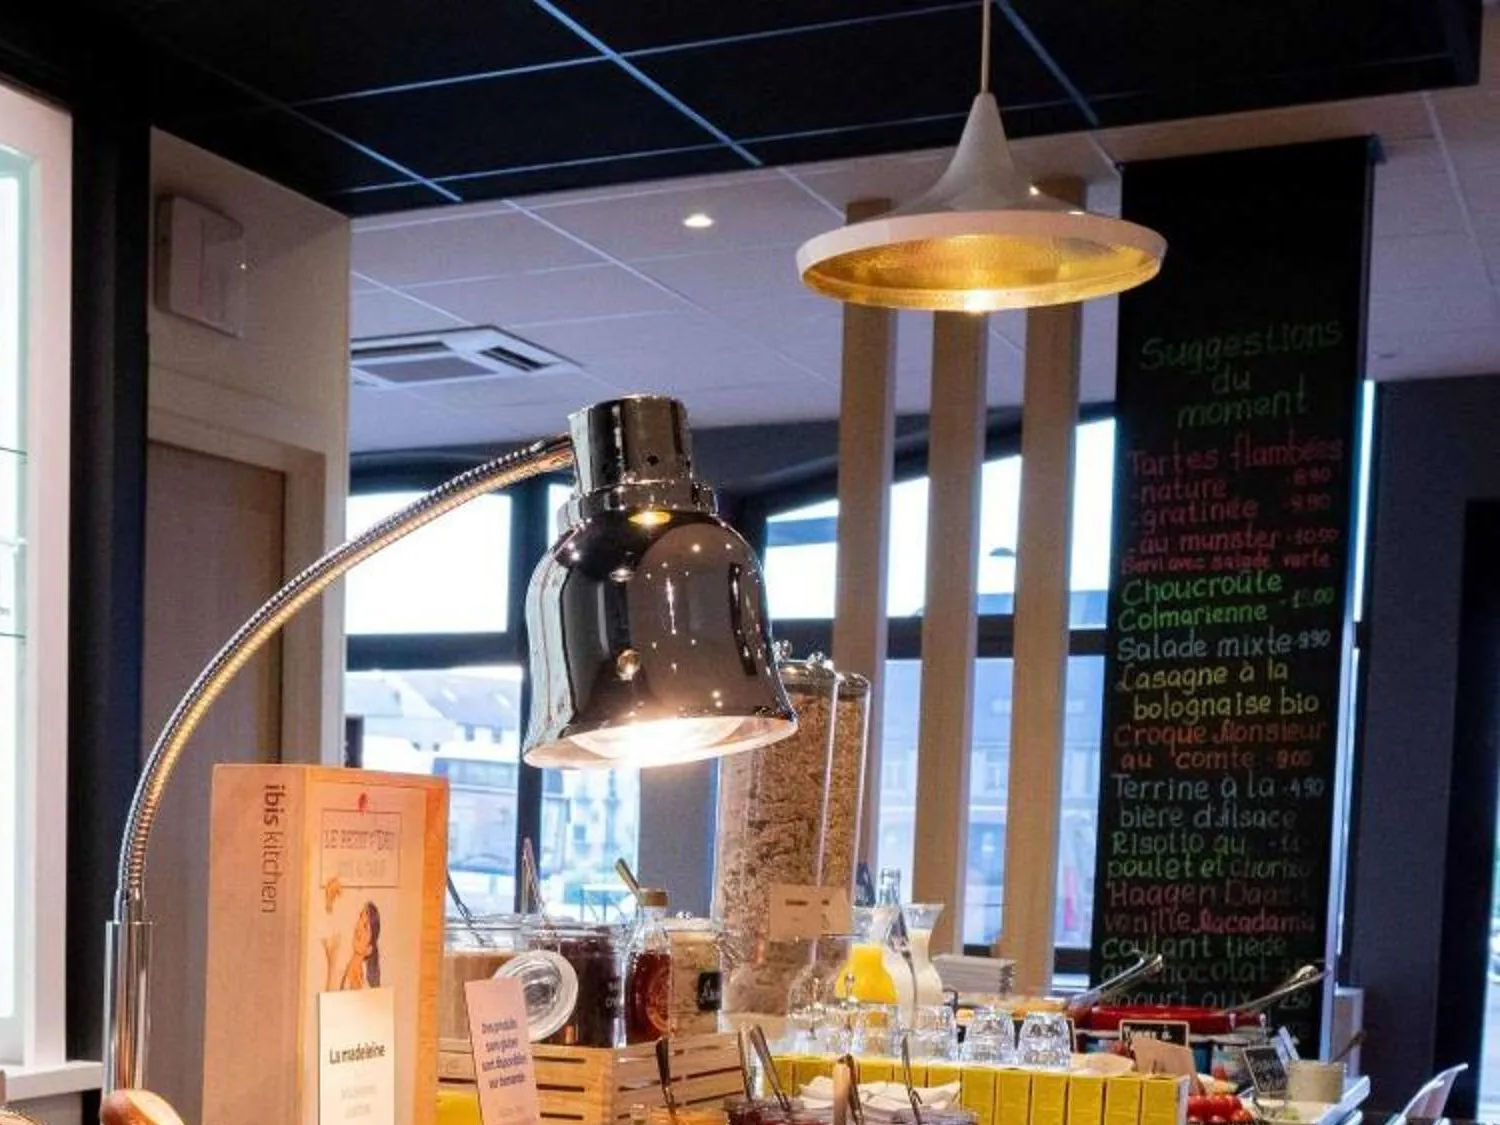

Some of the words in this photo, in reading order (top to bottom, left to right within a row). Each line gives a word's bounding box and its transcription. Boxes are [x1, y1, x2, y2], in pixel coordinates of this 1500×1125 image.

[1211, 362, 1251, 395] du
[1177, 373, 1311, 430] moment
[1129, 437, 1218, 476] Tartes
[1118, 603, 1269, 632] Colmarienne
[1117, 627, 1209, 662] Salade
[1217, 625, 1293, 658] mixte
[1118, 662, 1229, 696] Lasagne
[1267, 656, 1288, 681] la
[1132, 690, 1273, 724] bolognaise
[1280, 686, 1320, 715] bio
[1113, 721, 1208, 757] Croque
[1121, 751, 1153, 769] au
[1110, 773, 1210, 800] Terrine
[1248, 769, 1275, 799] la
[264, 784, 285, 826] ibis
[1119, 803, 1184, 828] bière
[261, 831, 284, 913] kitchen
[329, 1047, 340, 1065] La
